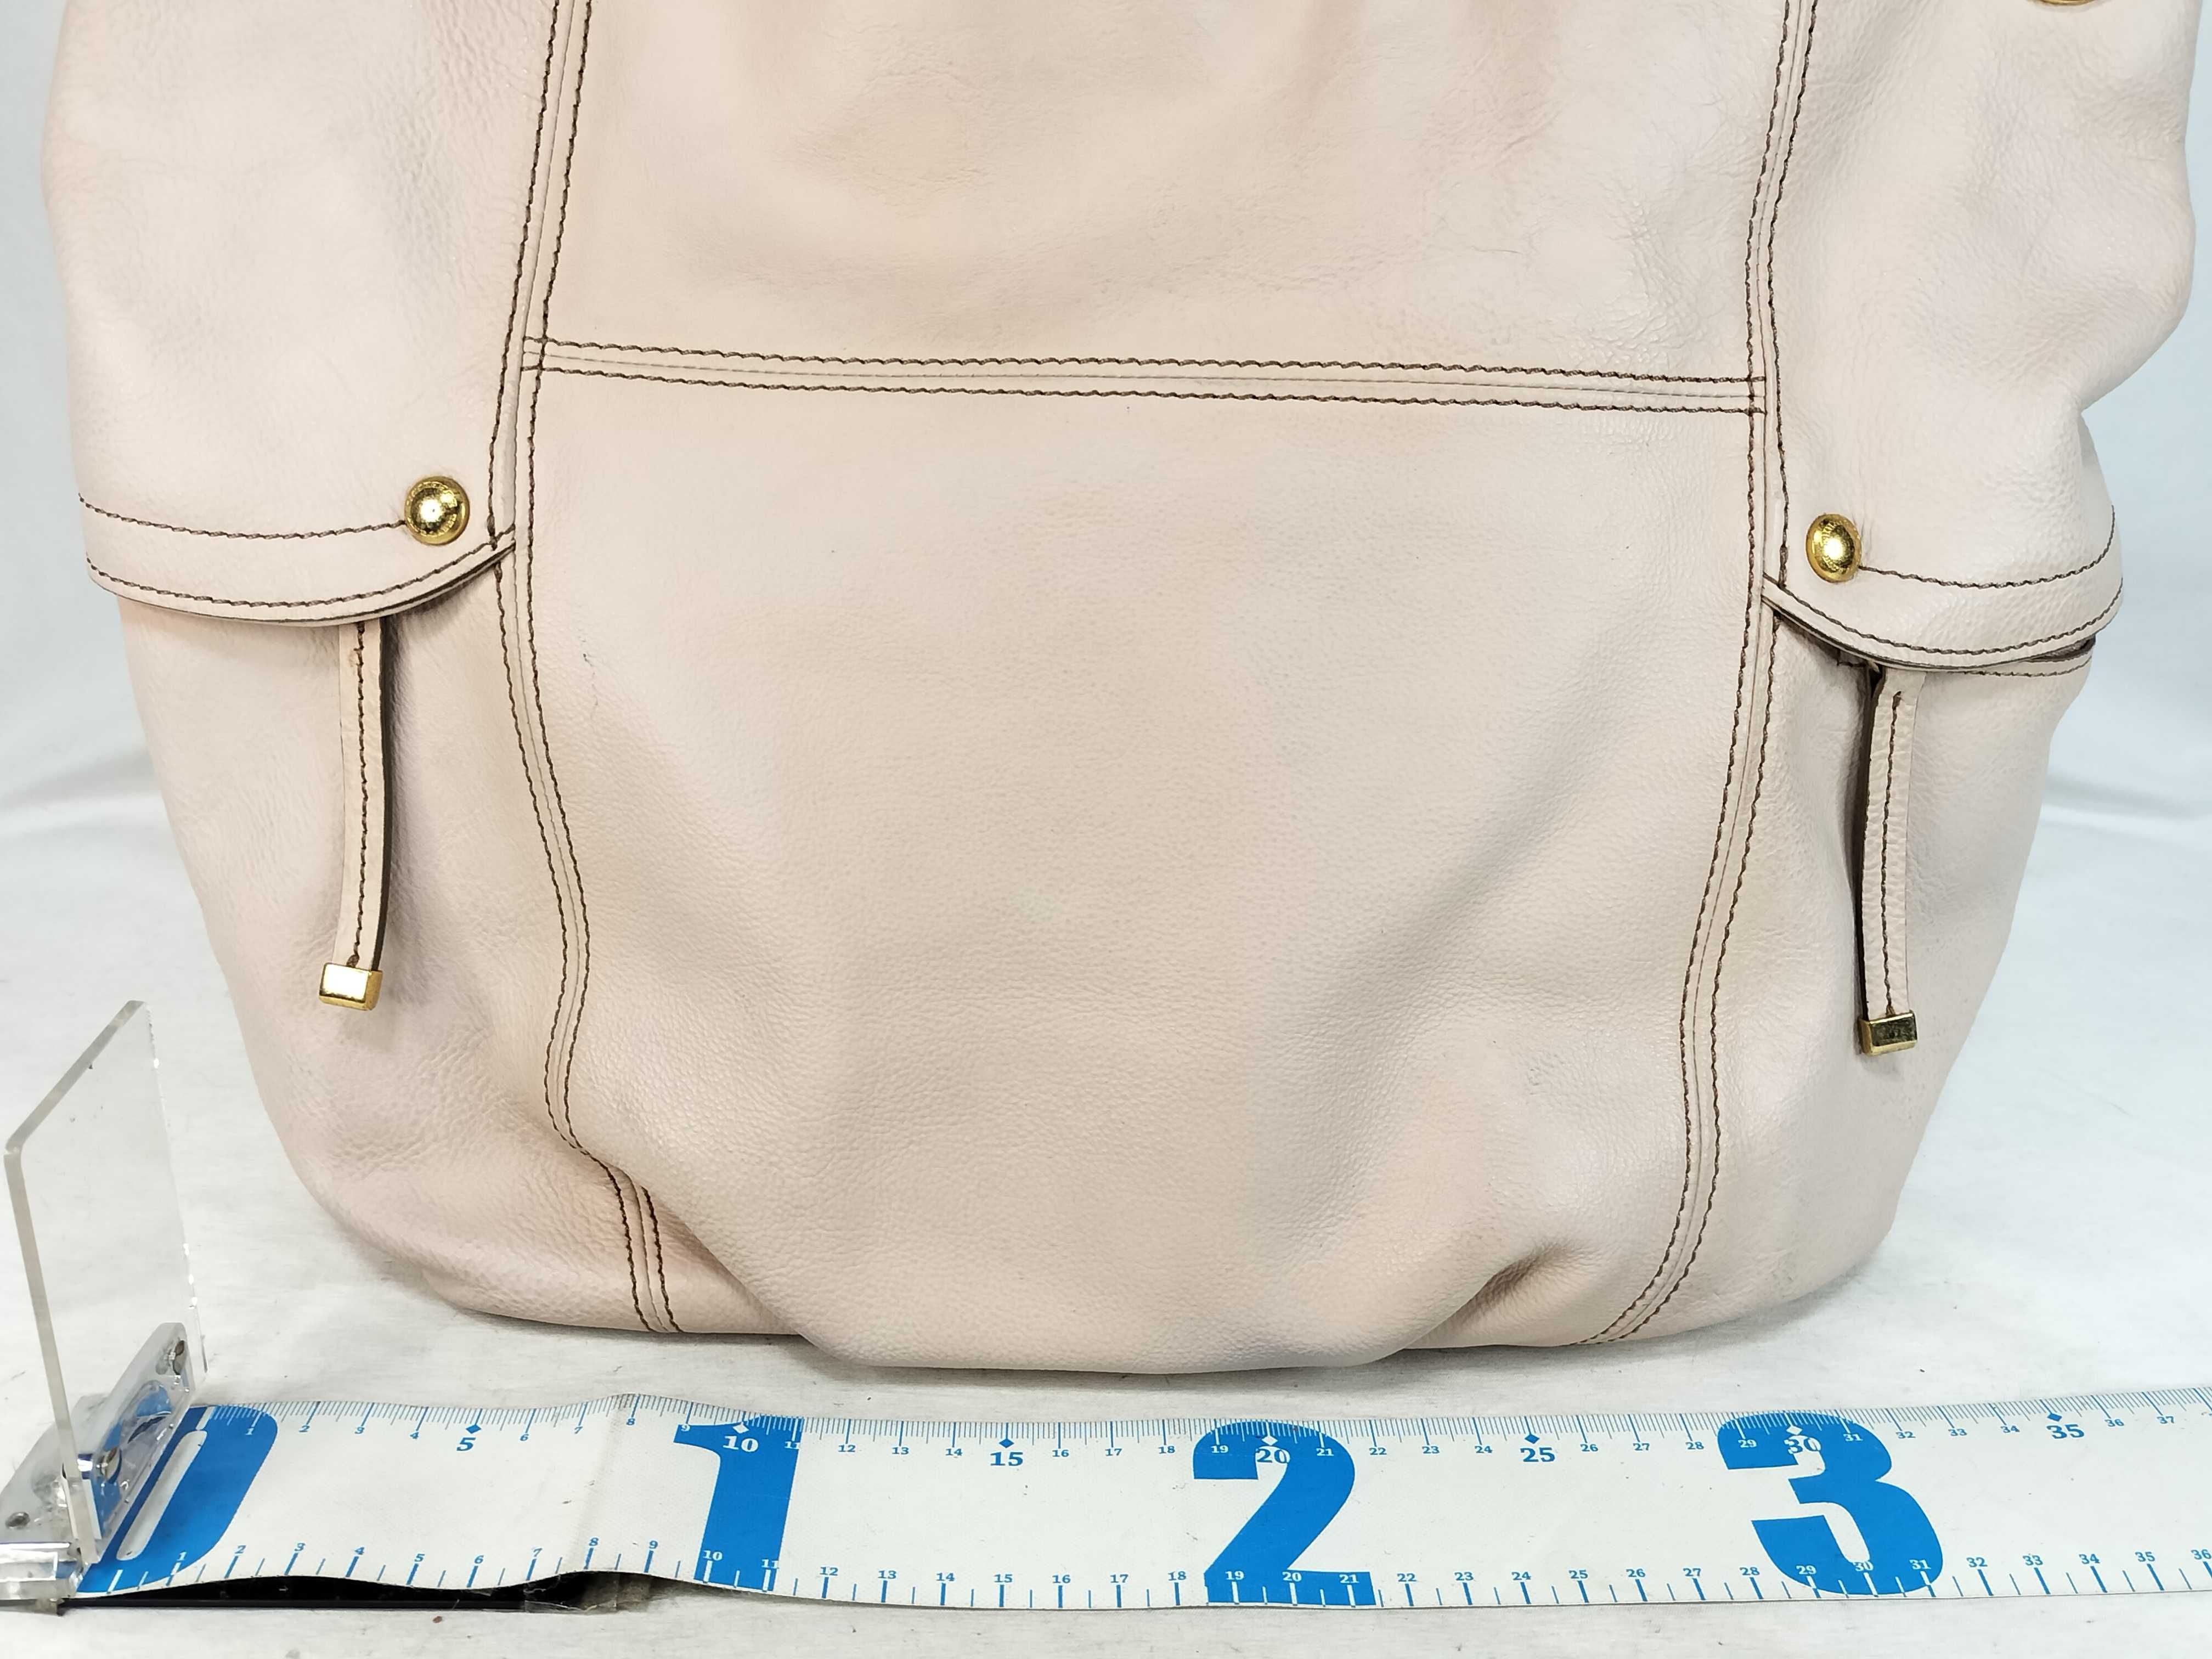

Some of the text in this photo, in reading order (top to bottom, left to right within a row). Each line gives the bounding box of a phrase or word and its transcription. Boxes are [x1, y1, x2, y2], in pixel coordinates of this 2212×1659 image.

[245, 1427, 255, 1436] 1
[456, 1437, 476, 1451] 5
[722, 1435, 759, 1452] 10
[784, 1441, 800, 1449] 11
[990, 1451, 1024, 1466] 15
[1052, 1449, 1069, 1457] 16
[1105, 1448, 1122, 1456] 17
[1158, 1446, 1176, 1454] 18
[1211, 1445, 1229, 1454] 19
[1255, 1446, 1290, 1464] 20
[1316, 1448, 1334, 1457] 21
[1369, 1447, 1387, 1455] 22
[1422, 1446, 1440, 1454] 23
[1474, 1445, 1492, 1453] 24
[1520, 1447, 1555, 1463] 25
[1580, 1443, 1599, 1452] 26
[1633, 1443, 1650, 1451] 27
[1685, 1441, 1704, 1450] 28
[1738, 1439, 1757, 1448] 29
[1784, 1435, 1821, 1454] 30
[1843, 1434, 1864, 1442] 31
[1895, 1431, 1916, 1440] 32
[1948, 1428, 1968, 1437] 33
[2000, 1425, 2020, 1434] 34
[2046, 1424, 2085, 1440] 35
[2104, 1419, 2125, 1427] 36
[2157, 1415, 2175, 1424] 37
[76, 1404, 1943, 1606] 0 1 2 3
[178, 1537, 2212, 1583] 1 2 3 4 5 6 7 8 9 10 11 12 13 14 15 16 17 18 19 20 21 22 23 24 25 26 27 28 29 30 31 32 33 34 35 36
